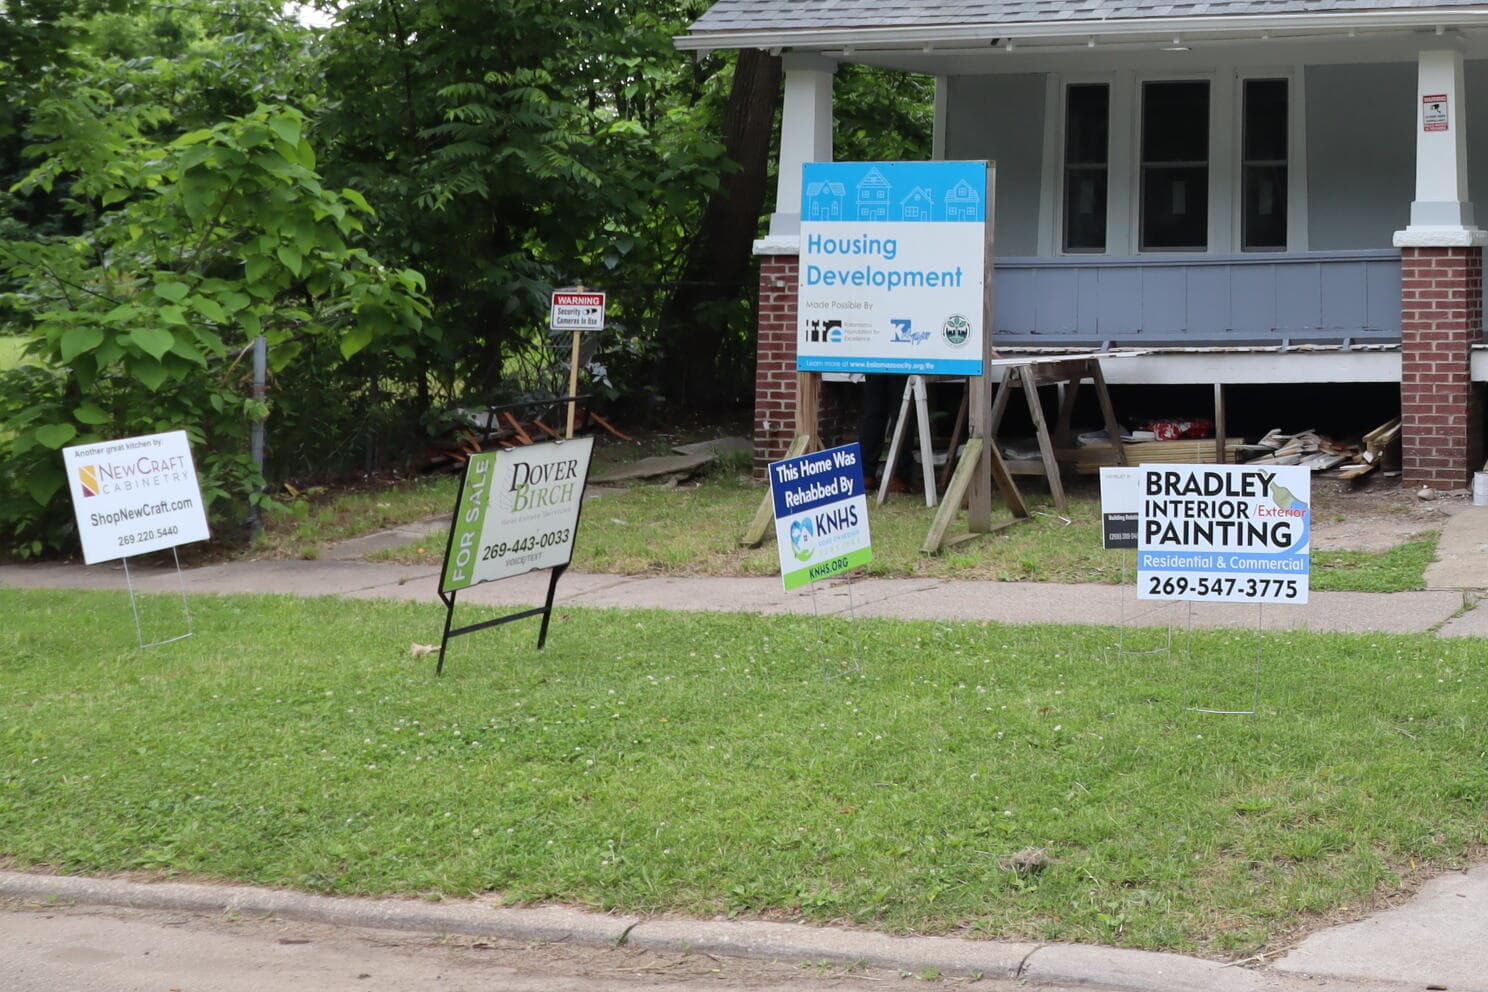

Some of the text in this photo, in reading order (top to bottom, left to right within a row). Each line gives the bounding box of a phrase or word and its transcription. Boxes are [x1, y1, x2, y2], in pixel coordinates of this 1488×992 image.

[808, 234, 897, 260] Housing
[807, 265, 963, 291] Development
[557, 296, 600, 305] WARNING
[557, 308, 580, 316] Security
[806, 301, 874, 310] Made Possible By
[74, 446, 104, 457] Another
[106, 444, 125, 455] great
[126, 440, 152, 451] kitchen
[509, 459, 578, 492] DOVER
[776, 451, 856, 483] This Home Was
[102, 472, 188, 495] CABINETRY
[785, 476, 854, 508] Rehabbed By
[1146, 471, 1276, 497] BRADLEY
[511, 482, 575, 513] BIRCH
[1145, 500, 1250, 519] INTERIOR
[1253, 504, 1307, 518] /Exterior
[90, 498, 193, 527] ShopNewCraft.com
[452, 459, 489, 582] FOR SALE
[815, 505, 858, 537] KNHS
[118, 525, 179, 546] 269.220.5440
[482, 528, 570, 561] 269-443-0033
[1145, 520, 1292, 548] PAINTING
[809, 557, 849, 580] KNHS.ORG
[1143, 554, 1304, 571] Residential & Commercial
[1149, 576, 1298, 599] 269-547-3775
